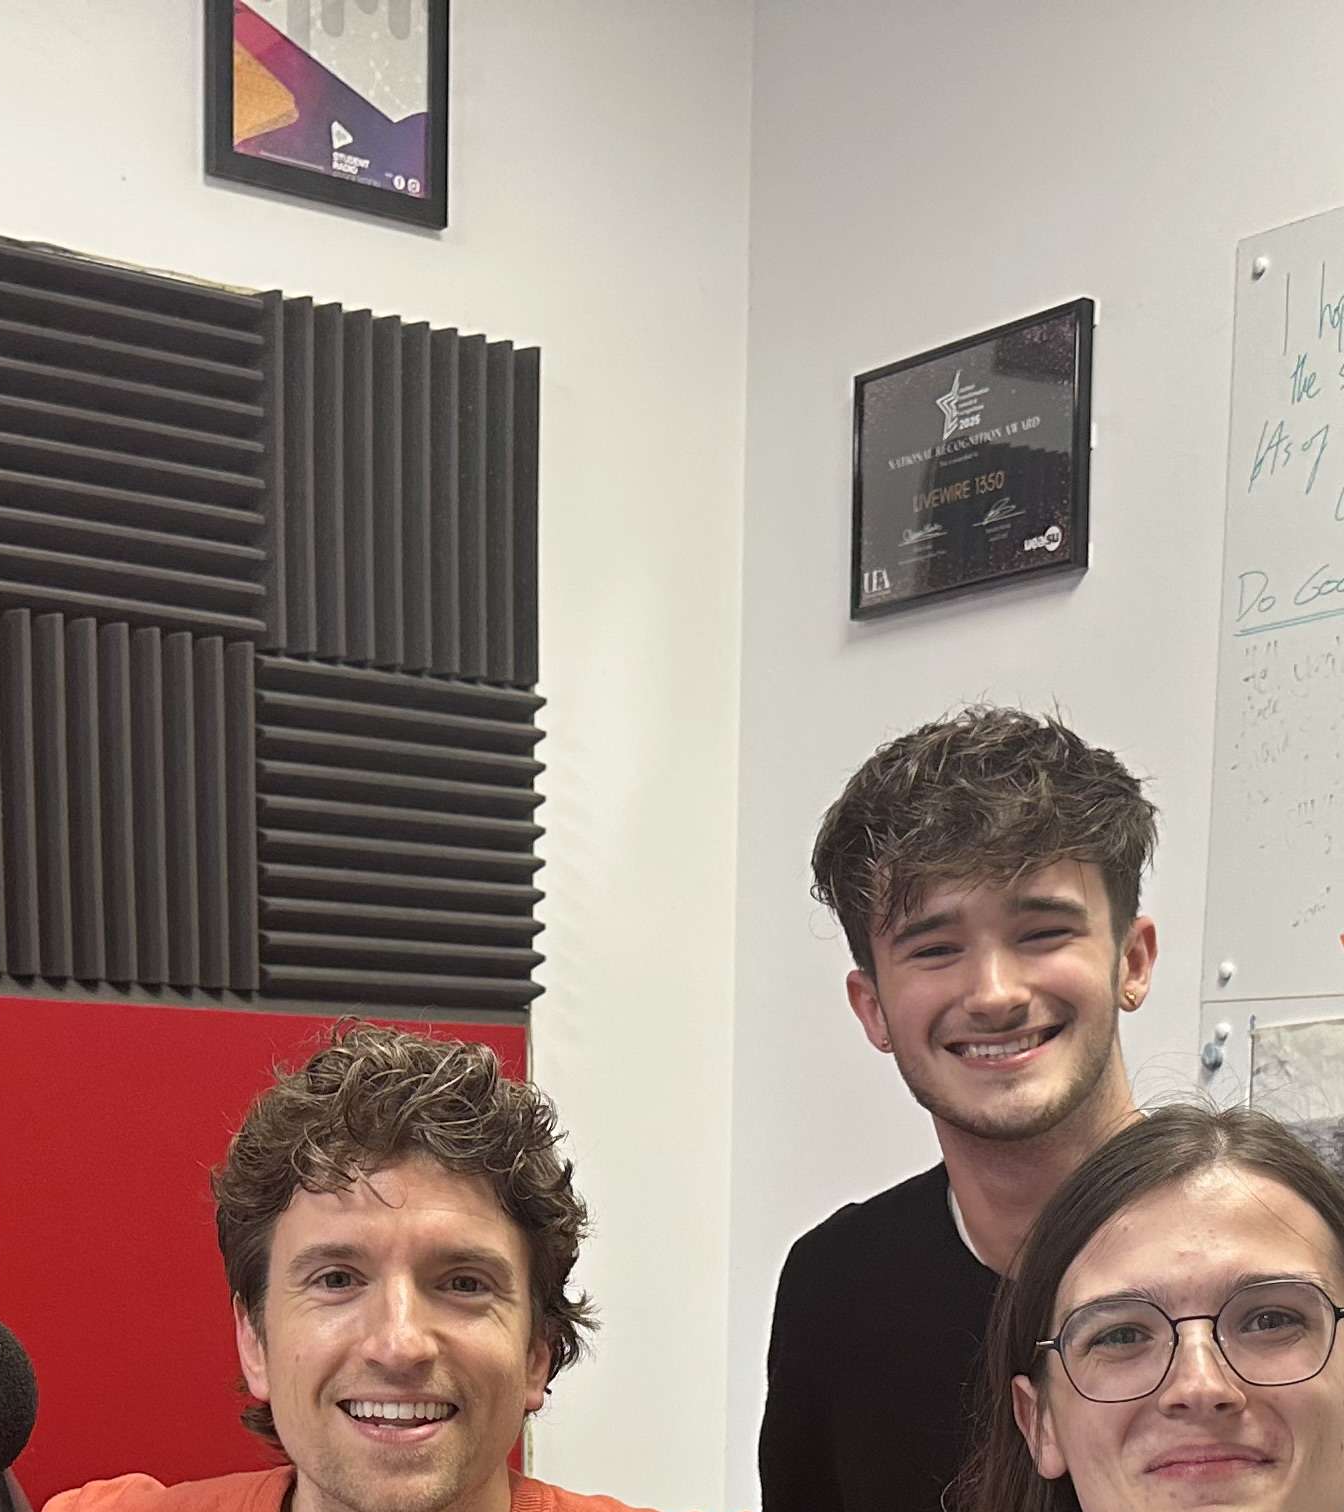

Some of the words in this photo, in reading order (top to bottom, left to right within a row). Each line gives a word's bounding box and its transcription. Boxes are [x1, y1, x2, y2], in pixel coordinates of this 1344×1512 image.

[1282, 271, 1291, 357] I
[1290, 352, 1322, 405] the
[912, 480, 971, 513] LIVEWIRE
[974, 471, 1006, 495] 1350
